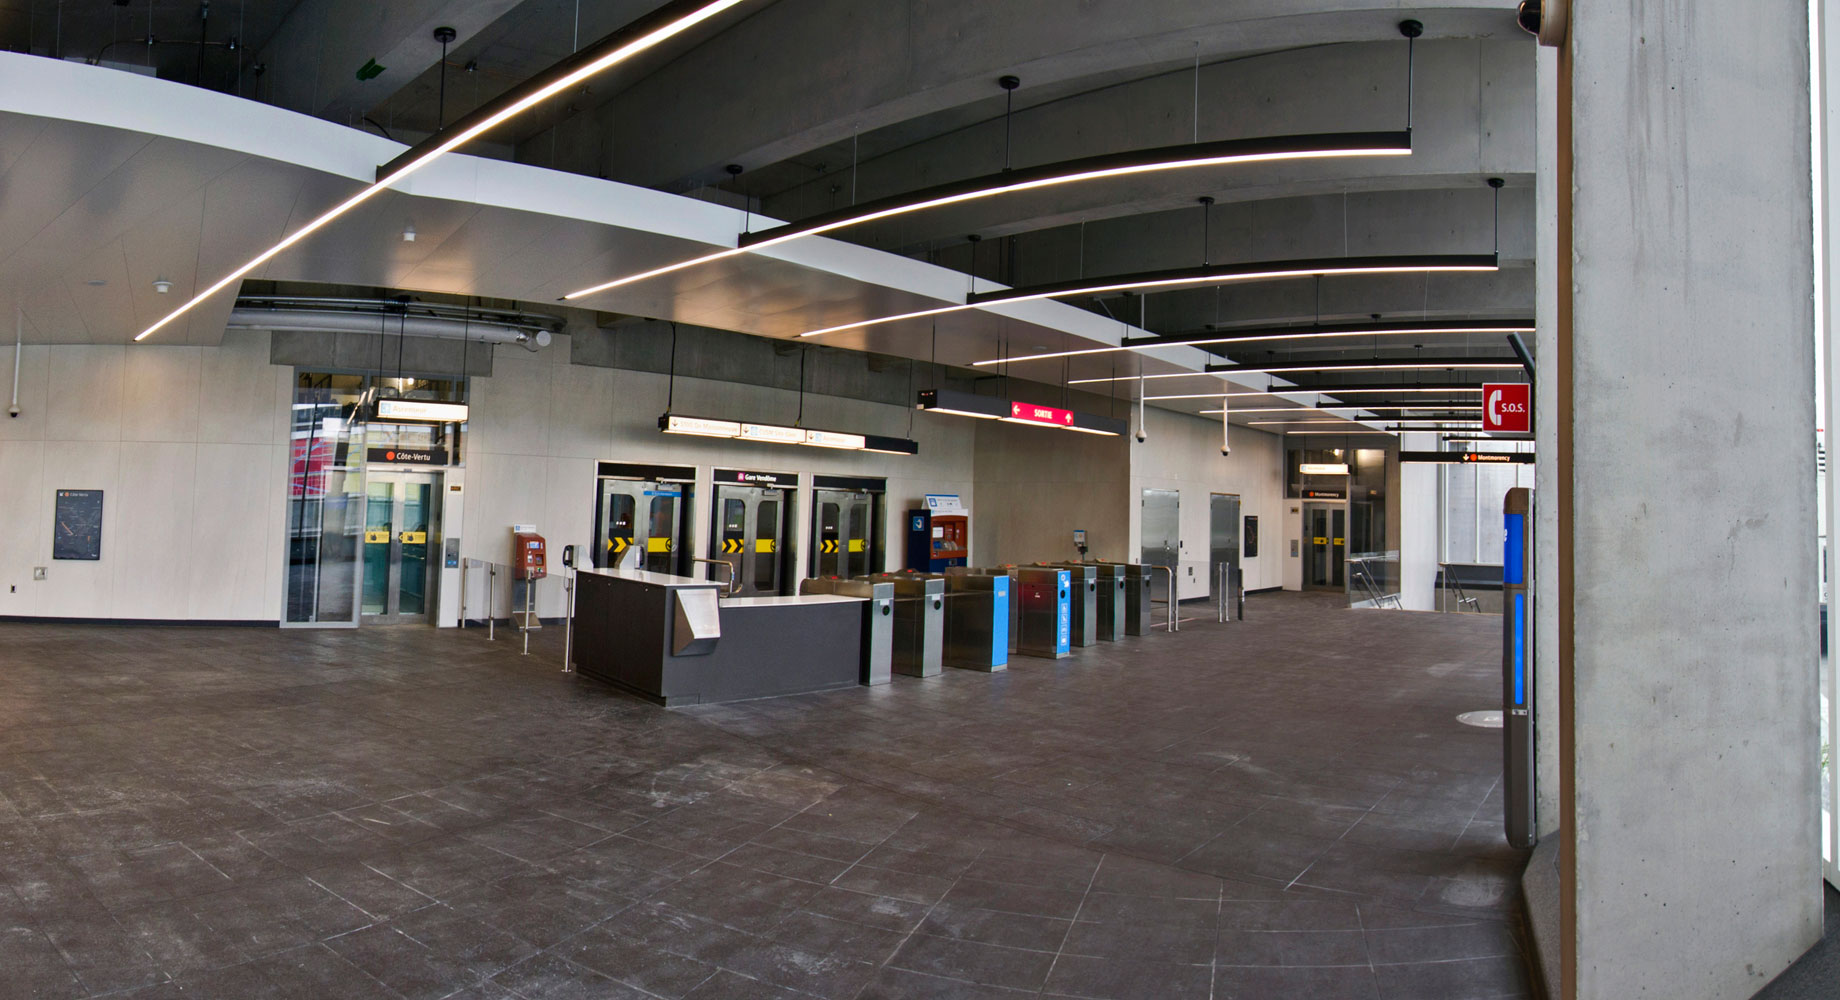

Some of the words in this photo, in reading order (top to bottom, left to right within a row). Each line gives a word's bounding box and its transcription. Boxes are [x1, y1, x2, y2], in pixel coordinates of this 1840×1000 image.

[1501, 403, 1526, 413] S.O.S.
[1034, 408, 1053, 419] SORTIE
[396, 452, 431, 461] Côte-Vertu
[1478, 454, 1510, 462] Montmorency
